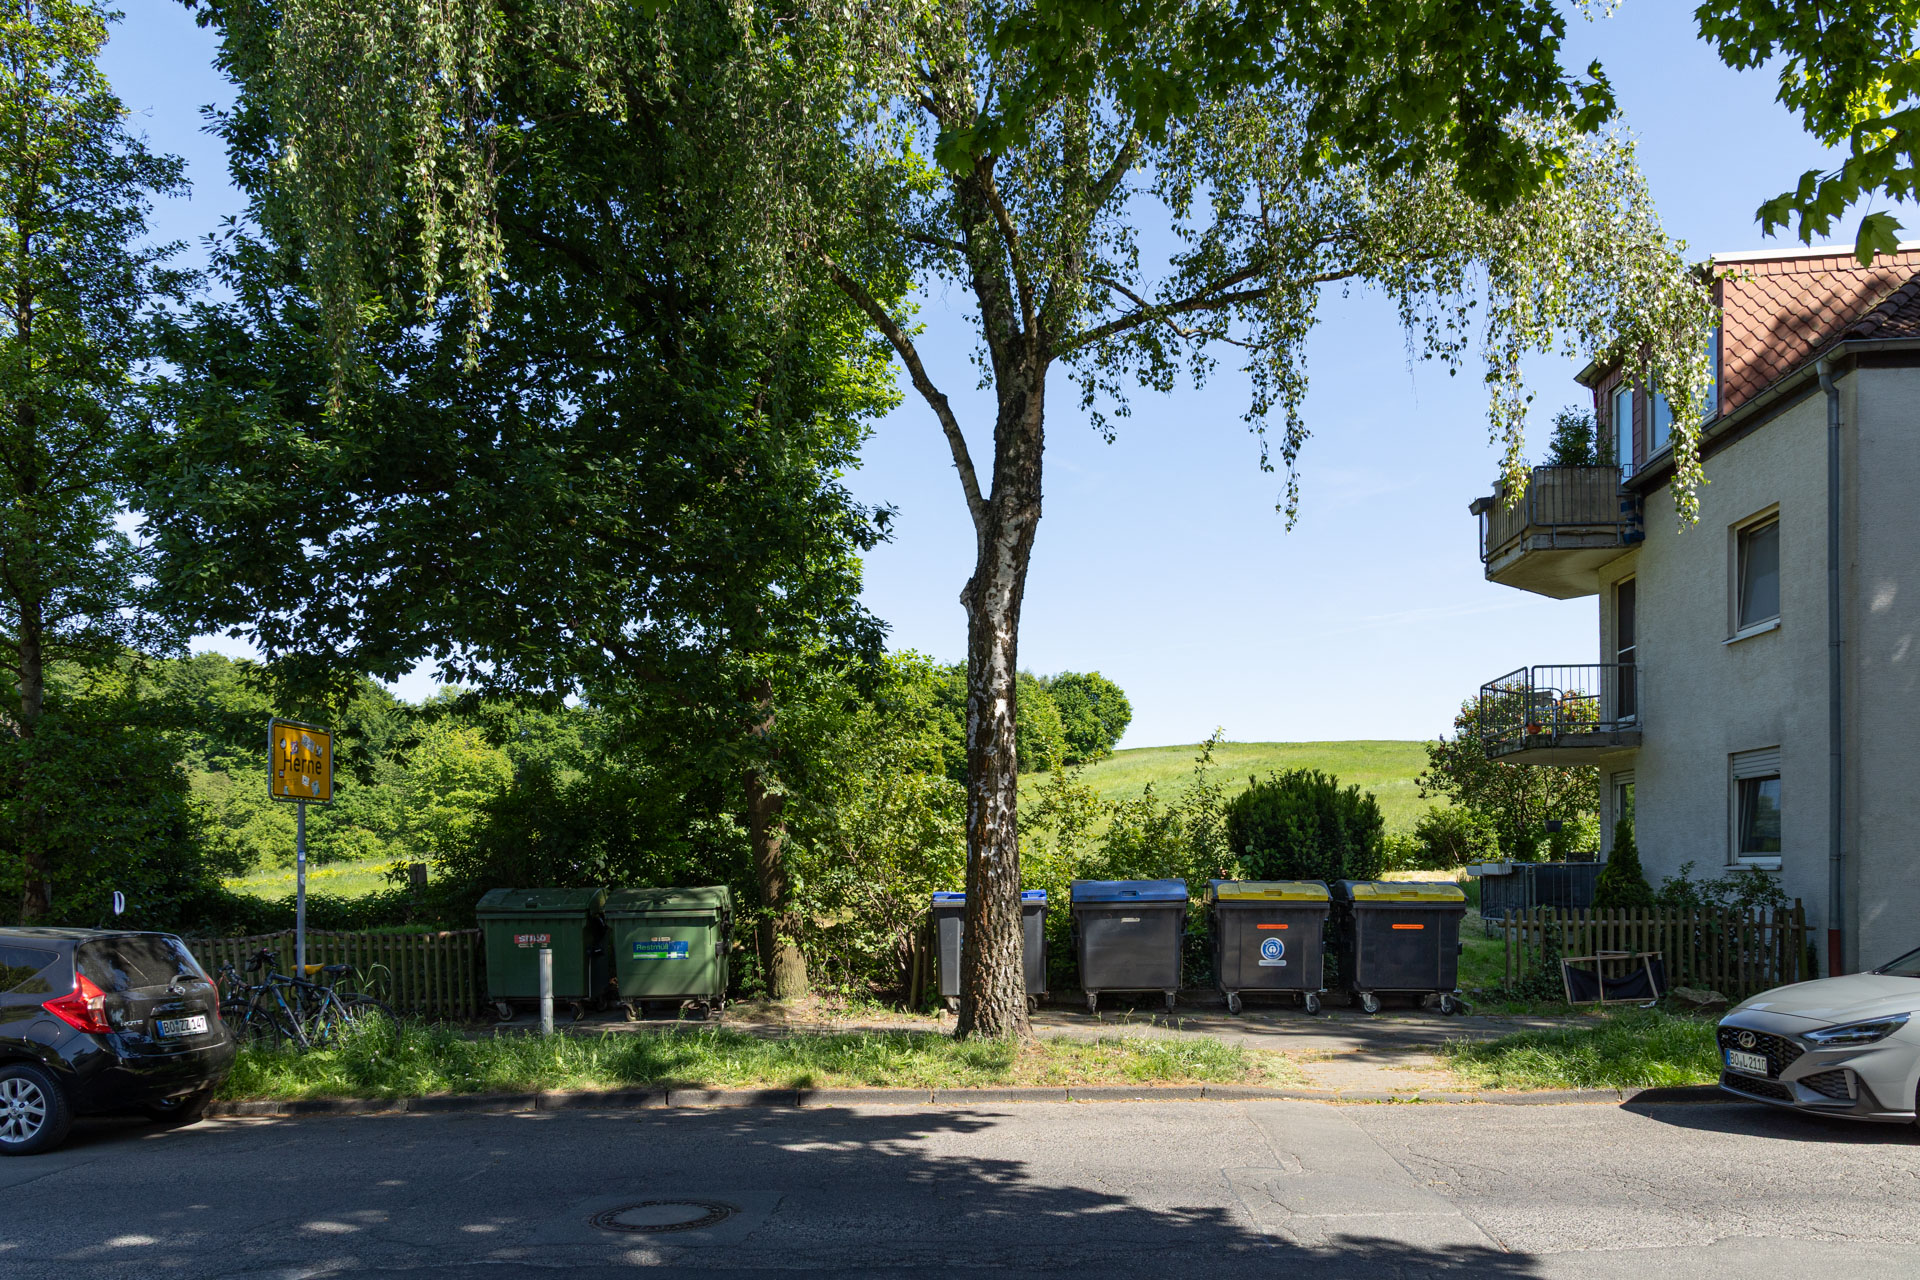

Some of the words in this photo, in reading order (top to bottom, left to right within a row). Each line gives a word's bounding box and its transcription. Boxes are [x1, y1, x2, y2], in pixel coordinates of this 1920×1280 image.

[284, 750, 322, 775] Herne
[636, 943, 669, 951] Restmüll
[163, 1021, 176, 1034] BO
[179, 1019, 191, 1031] ZZ
[192, 1017, 205, 1030] 147
[1730, 1052, 1739, 1066] BO
